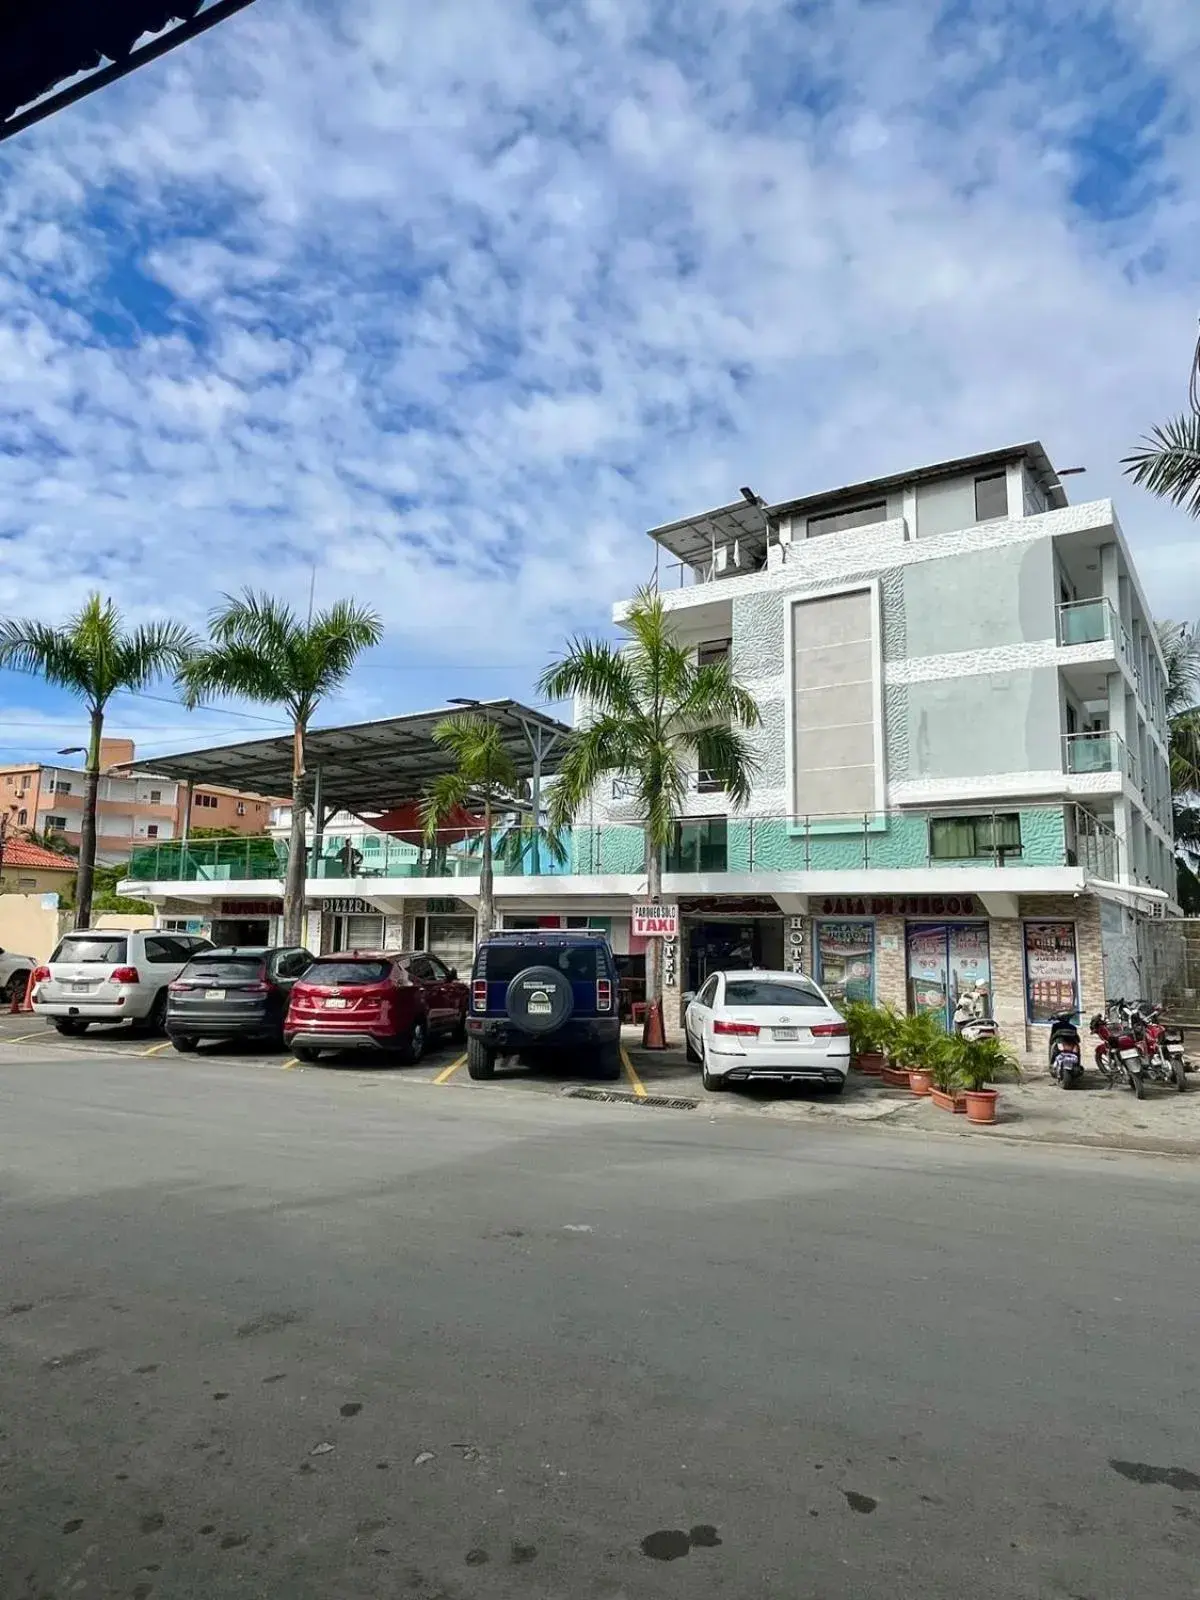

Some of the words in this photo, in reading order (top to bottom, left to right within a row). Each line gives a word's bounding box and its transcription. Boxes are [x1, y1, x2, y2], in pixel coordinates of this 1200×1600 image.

[822, 896, 867, 915] SALA
[897, 896, 975, 915] JUEGOS
[635, 919, 675, 932] TAXI
[663, 935, 677, 985] OTEL
[789, 916, 803, 974] HOTE
